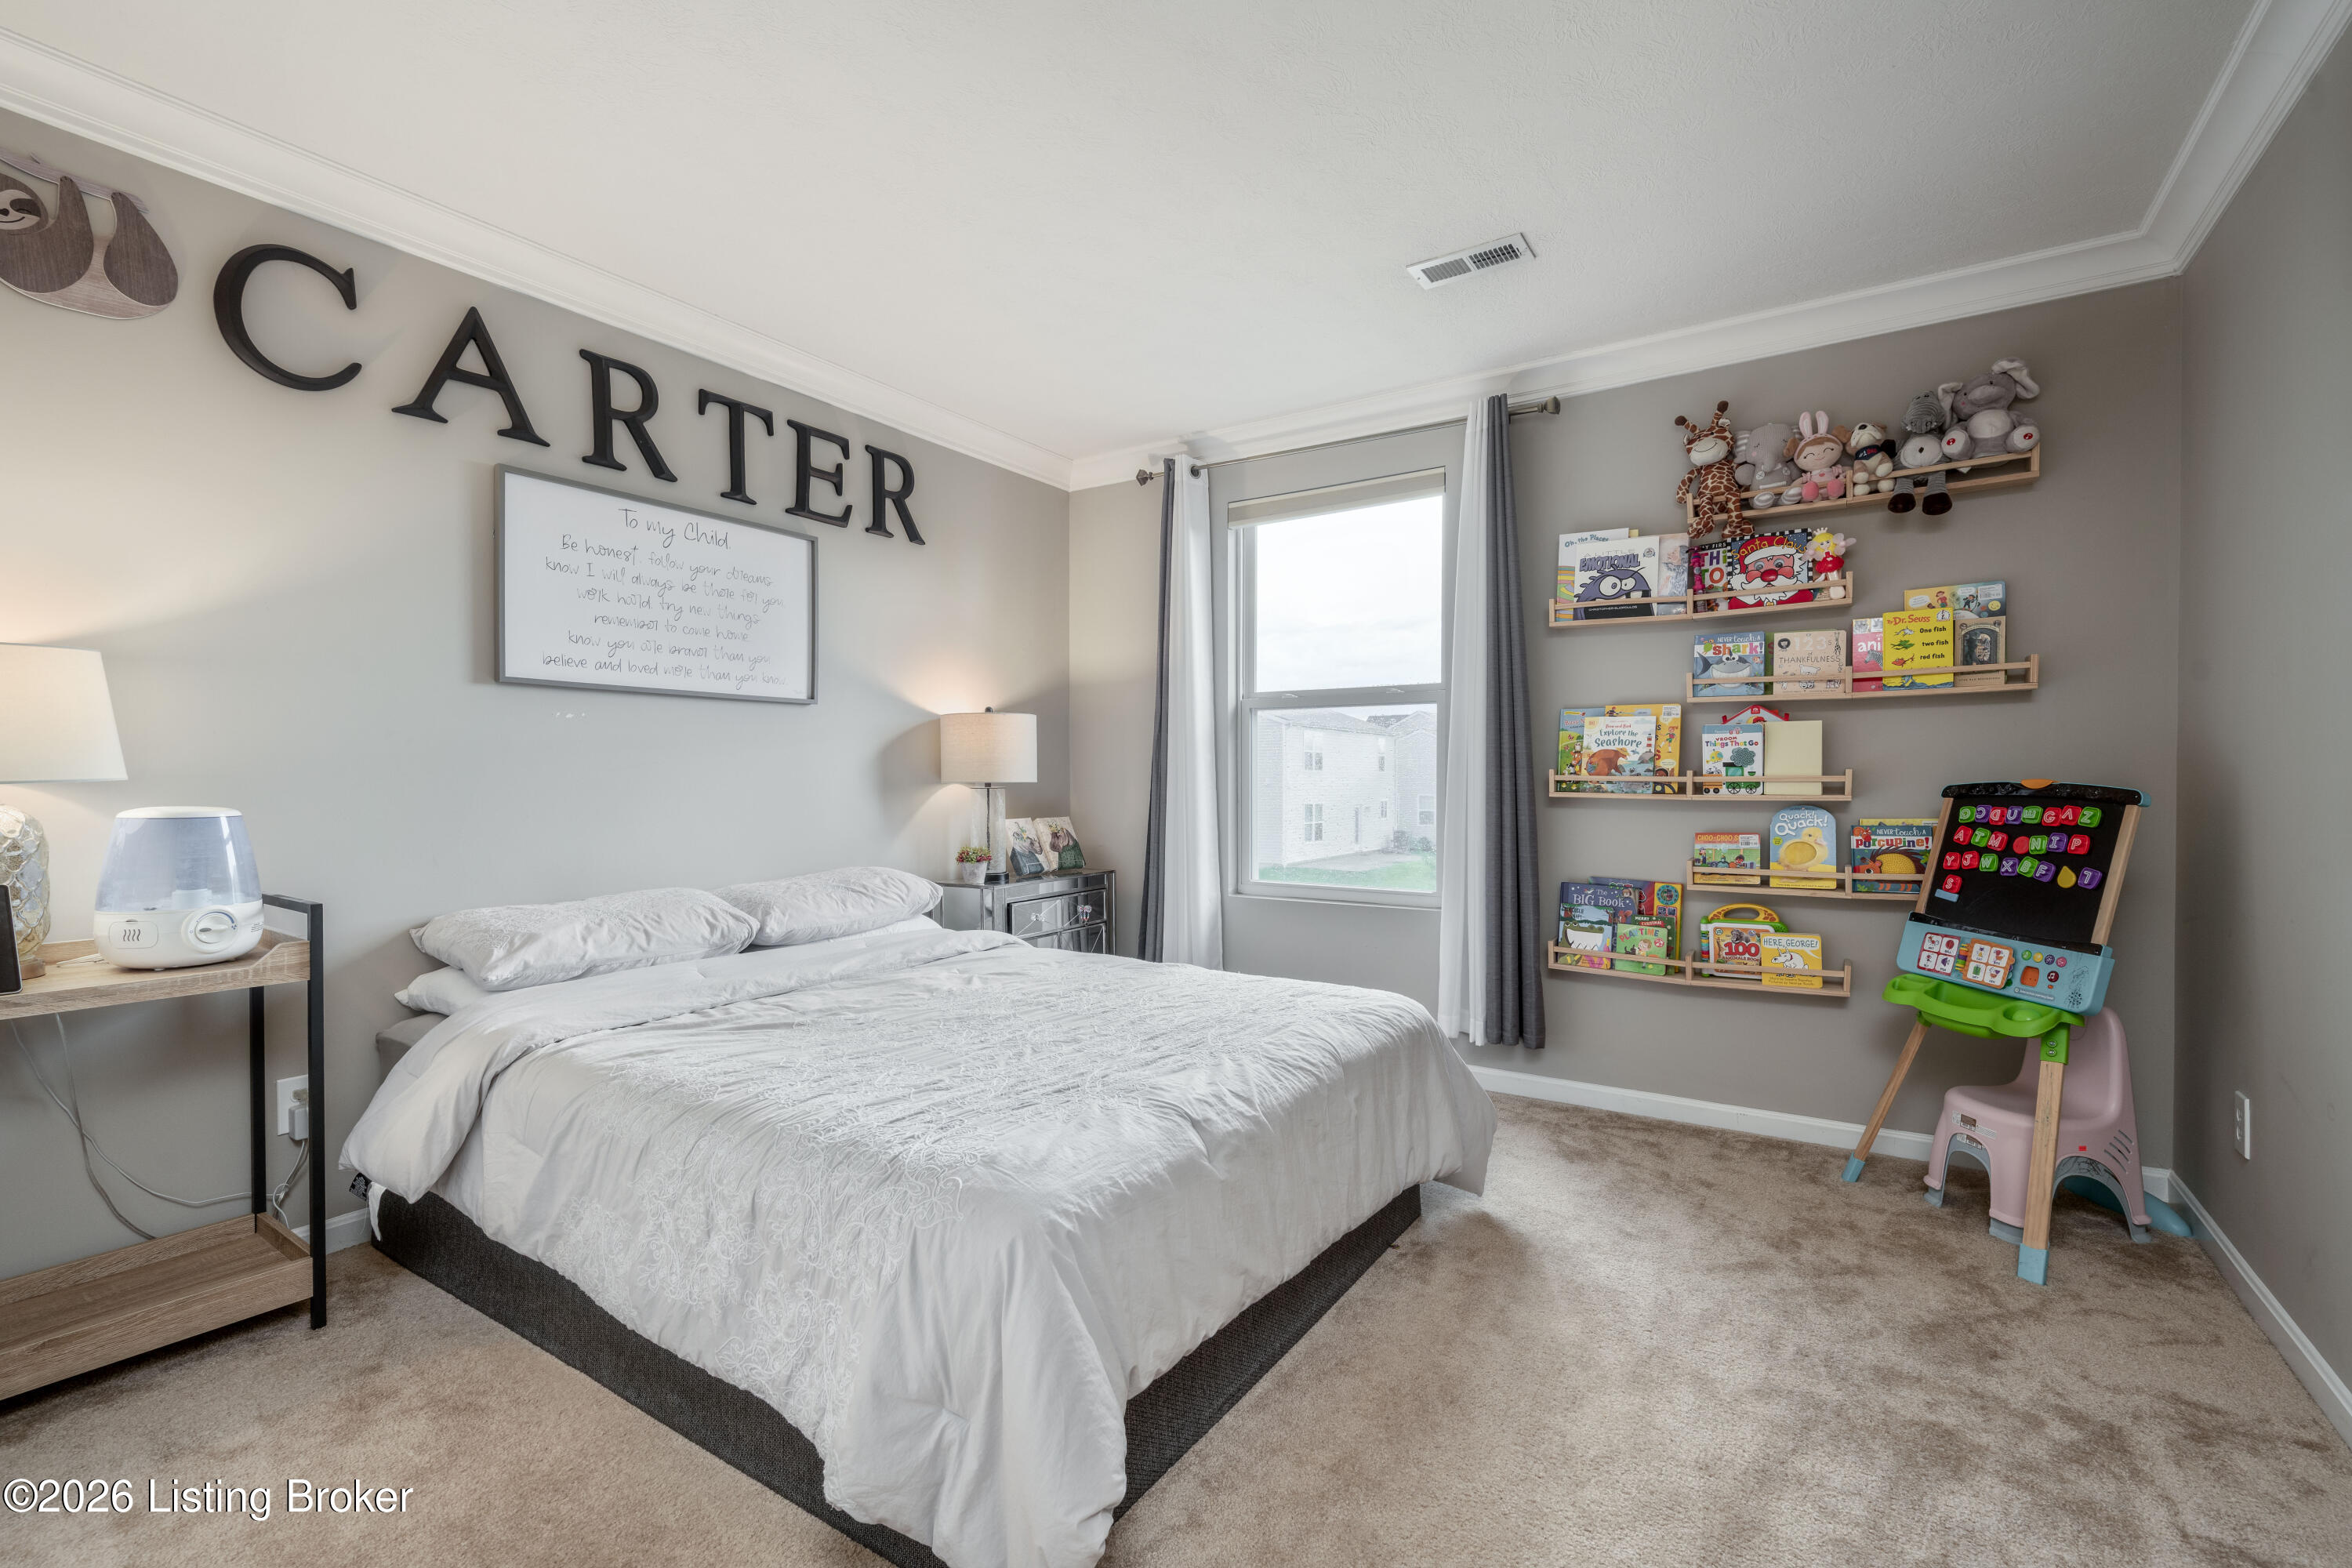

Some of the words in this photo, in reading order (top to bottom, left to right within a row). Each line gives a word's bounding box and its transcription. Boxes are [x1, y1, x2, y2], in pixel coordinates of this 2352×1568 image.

[212, 244, 927, 546] CARTER
[618, 508, 638, 529] To
[646, 520, 675, 549] my
[1731, 538, 1769, 561] Santa
[1773, 535, 1807, 554] Claus
[560, 533, 579, 552] Be
[648, 550, 684, 572] follow
[689, 564, 720, 582] your
[725, 565, 774, 587] dreams
[1579, 554, 1641, 572] EMOTIONAL
[545, 555, 579, 575] know
[586, 562, 595, 577] I
[602, 566, 626, 585] will
[630, 572, 677, 598] always
[681, 576, 697, 593] be
[703, 580, 735, 600] there
[740, 590, 758, 604] for
[576, 587, 611, 604] work
[659, 597, 683, 622] try
[689, 605, 710, 617] new
[717, 604, 760, 630] things
[593, 614, 659, 632] remember
[664, 619, 677, 633] to
[682, 626, 710, 637] come
[716, 626, 750, 641] home
[1893, 616, 1907, 626] Dr.
[1907, 614, 1931, 624] Seuss
[1733, 633, 1757, 644] touch
[1857, 636, 1882, 652] ani
[566, 630, 602, 648] know
[607, 639, 635, 659] you
[639, 640, 662, 655] are
[669, 645, 707, 660] braver
[713, 644, 745, 663] than
[748, 655, 772, 673] you
[1712, 642, 1764, 656] shark!
[1779, 655, 1842, 664] THANKFULNESS
[543, 652, 587, 669] believe
[594, 659, 622, 673] and
[627, 659, 659, 677] loved
[664, 665, 693, 680] more
[698, 665, 731, 683] than
[735, 674, 757, 691] you
[1599, 728, 1627, 738] Explore
[1628, 728, 1639, 737] the
[1595, 736, 1642, 748] Seashore
[1705, 739, 1729, 749] Things
[1779, 811, 1815, 822] Quack!
[2043, 811, 2056, 823] G
[2079, 811, 2093, 823] Z
[1774, 815, 1828, 836] Quack!
[1893, 826, 1922, 837] touch
[1697, 833, 1735, 842] CHOO-CHOO
[1856, 837, 1930, 849] porcupine!
[1955, 829, 1964, 840] A
[1975, 831, 1984, 842] T
[2071, 839, 2082, 851] P
[1946, 855, 1955, 866] Y
[1962, 855, 1973, 866] J
[1980, 858, 1991, 868] W
[2002, 862, 2013, 872] X
[2020, 861, 2031, 873] B
[2036, 865, 2048, 877] F
[1945, 878, 1955, 889] S
[1573, 894, 1595, 906] BIG
[1599, 896, 1624, 908] Book
[1618, 927, 1660, 942] PLAYTIME
[1723, 942, 1760, 957] 100
[1763, 938, 1785, 948] HERE,
[1785, 938, 1818, 948] GEORGE!
